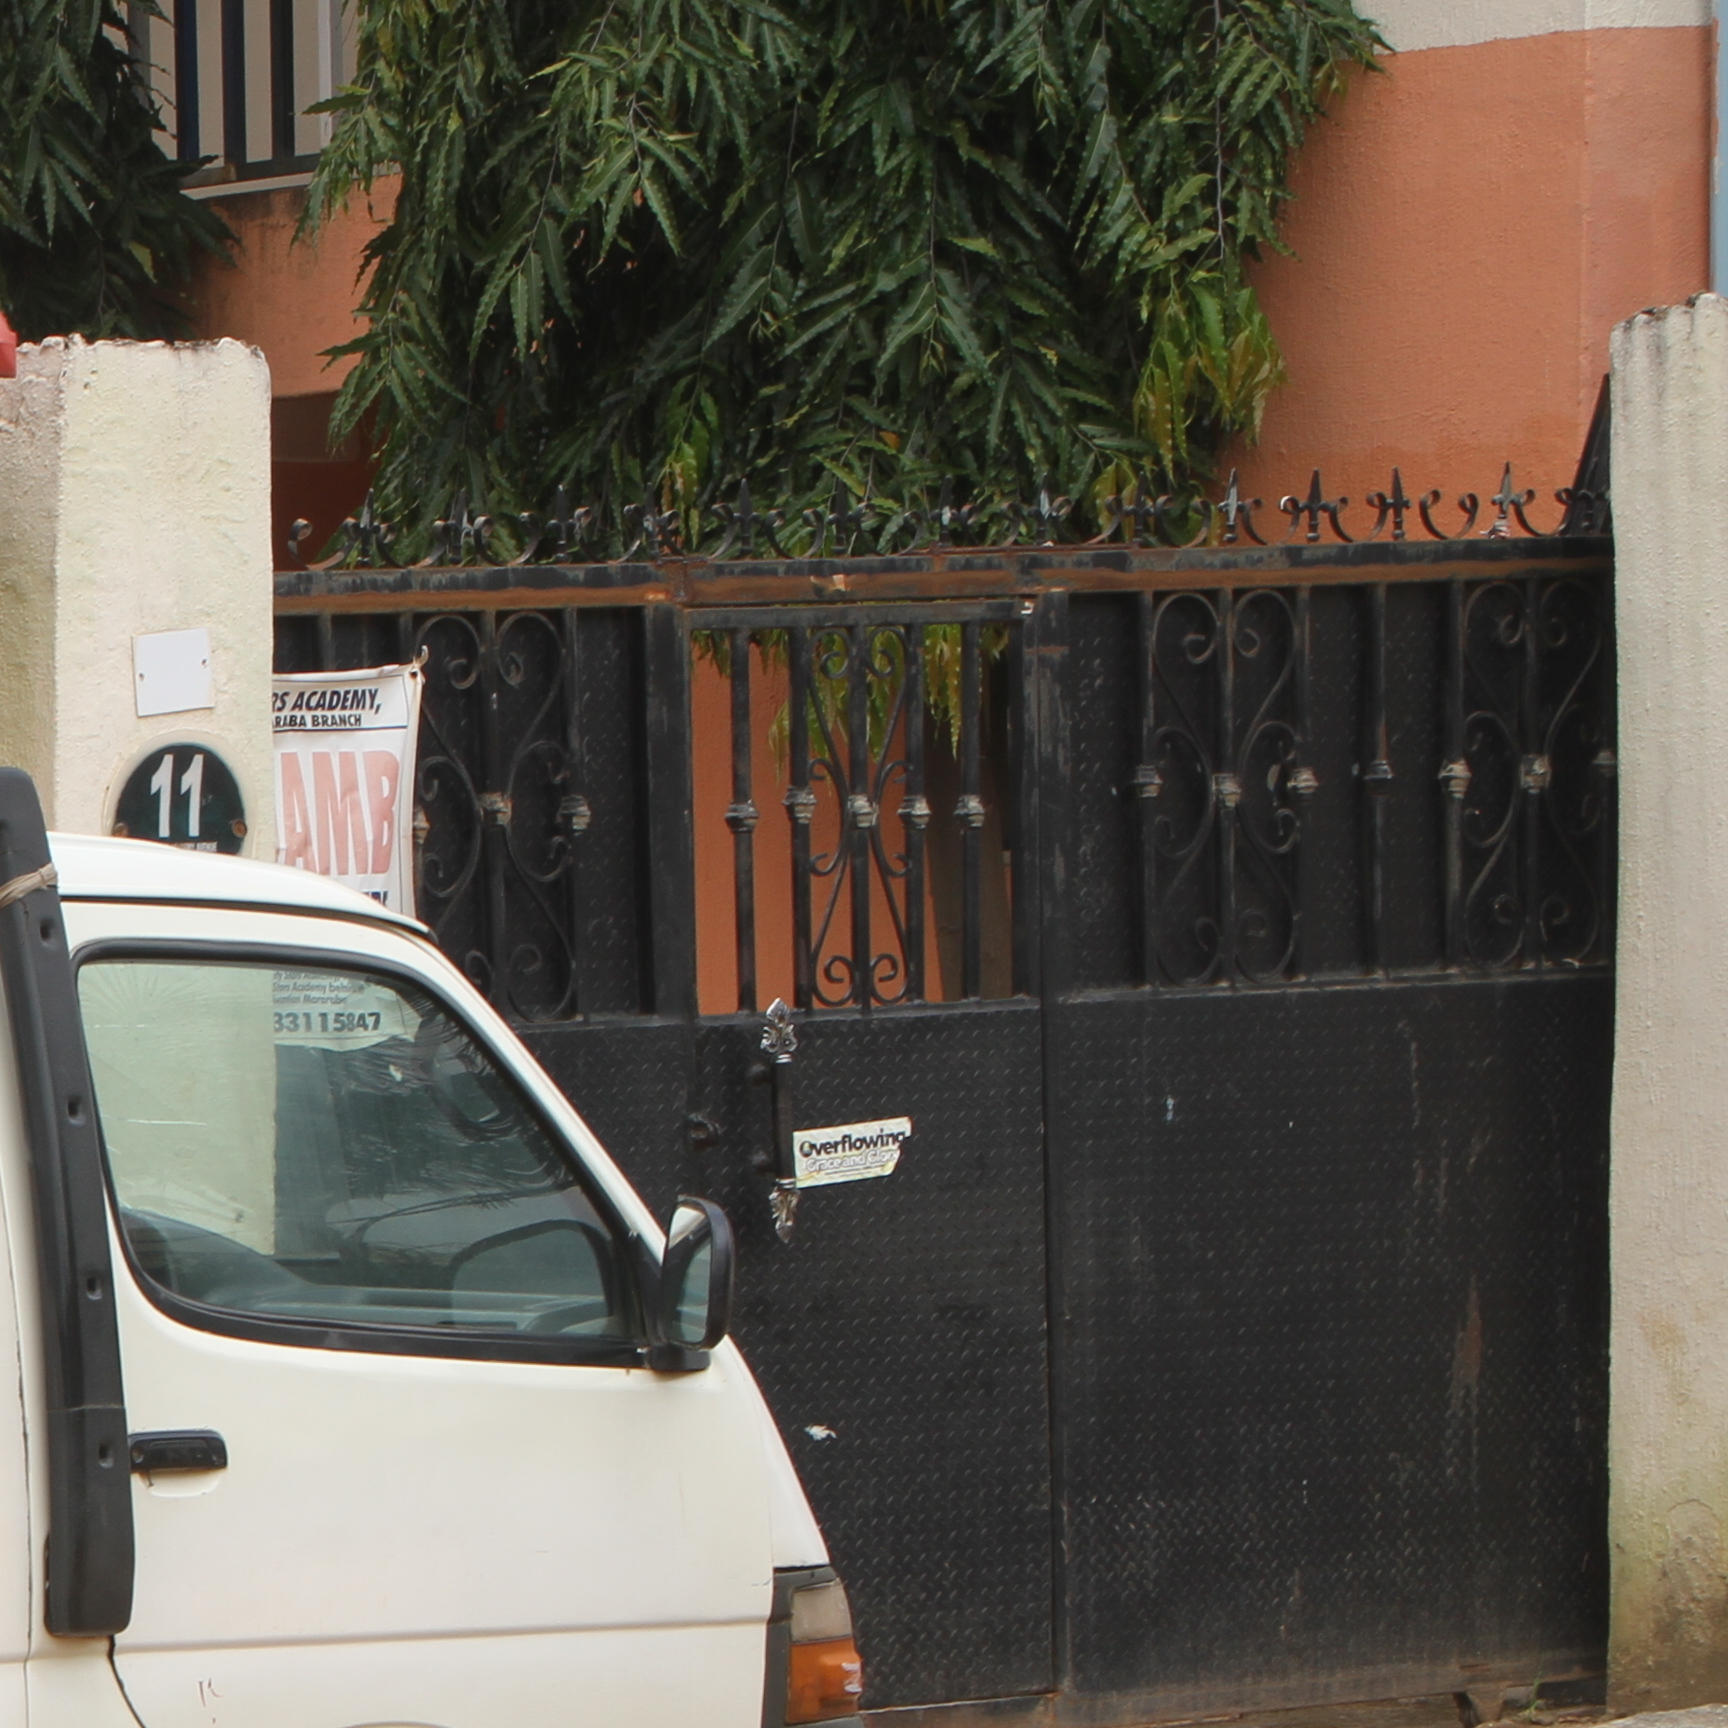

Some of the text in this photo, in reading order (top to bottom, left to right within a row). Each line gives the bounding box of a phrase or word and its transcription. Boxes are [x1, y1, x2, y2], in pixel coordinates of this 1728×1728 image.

[291, 687, 382, 716] ACADEMY,
[311, 714, 362, 727] BRANCH
[150, 754, 205, 838] 11
